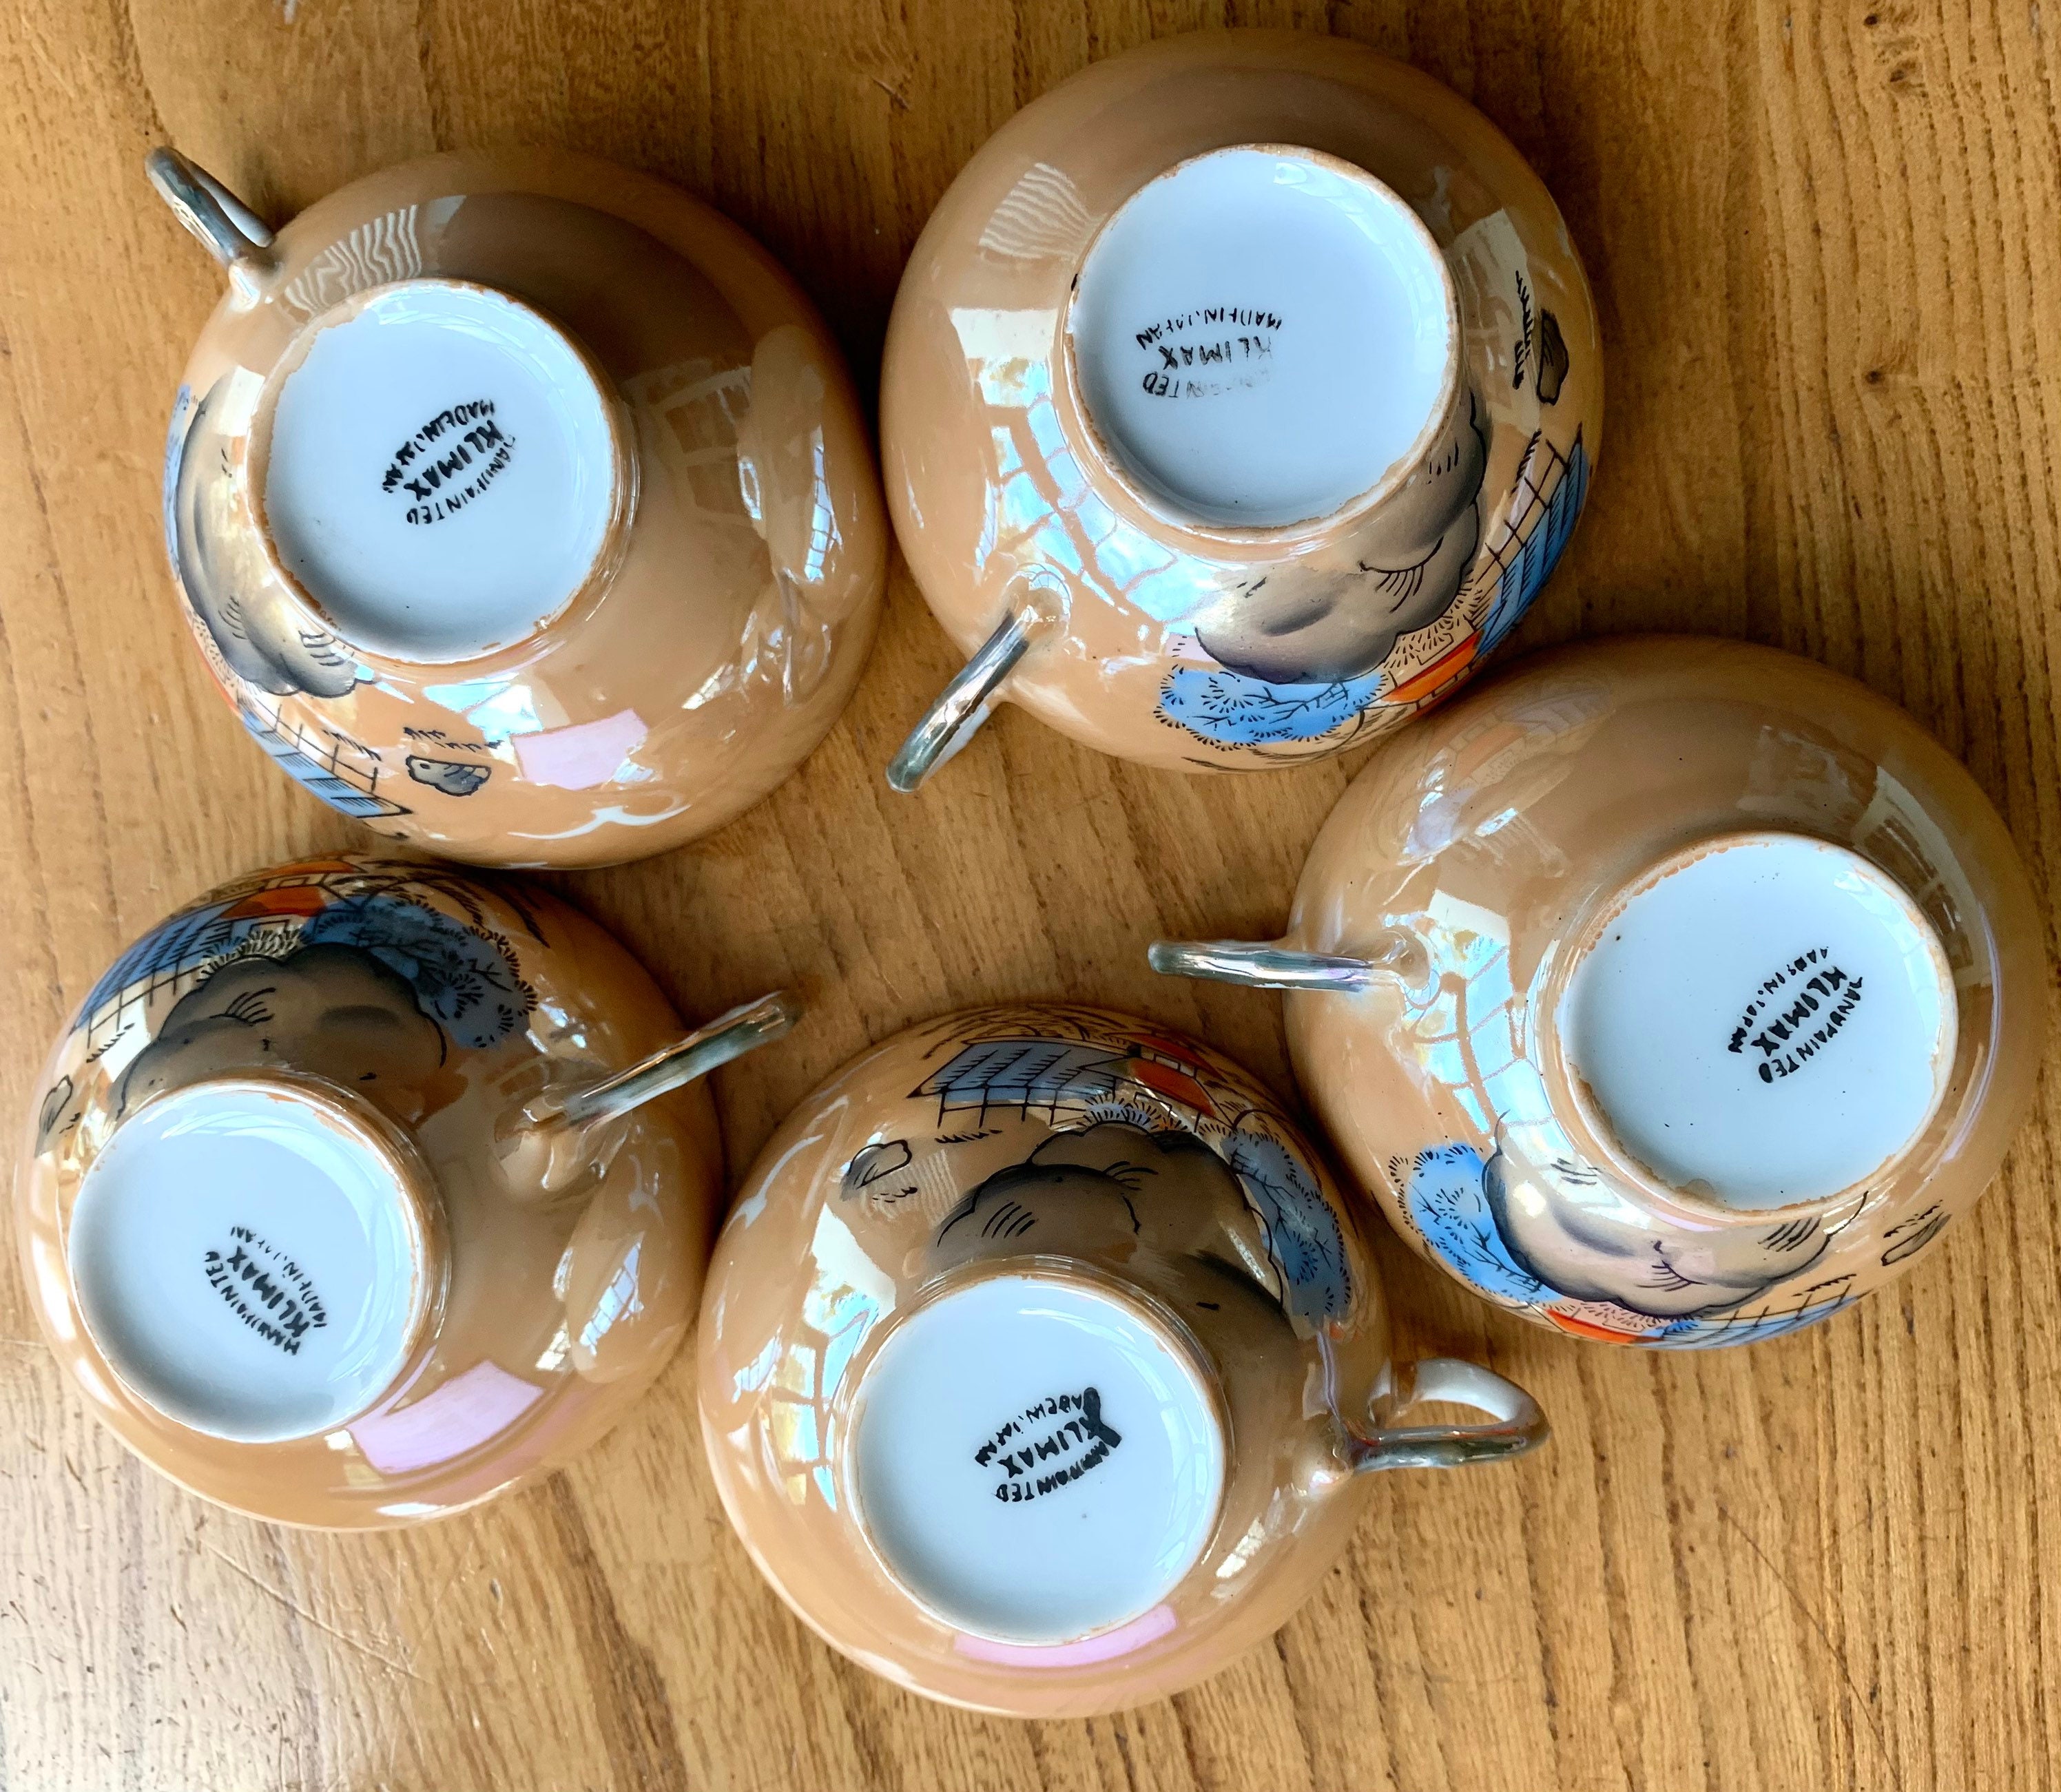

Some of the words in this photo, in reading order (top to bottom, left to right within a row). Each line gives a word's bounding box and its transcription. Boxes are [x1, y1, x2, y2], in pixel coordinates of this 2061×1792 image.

[1158, 335, 1273, 371] KLIMAX
[403, 419, 504, 502] KLIMAX
[1750, 965, 1847, 1057] KLIMAX
[227, 1245, 310, 1338] KLIMAX
[995, 1432, 1120, 1503] ANDPAINTED
[997, 1417, 1104, 1479] KLIMAX
